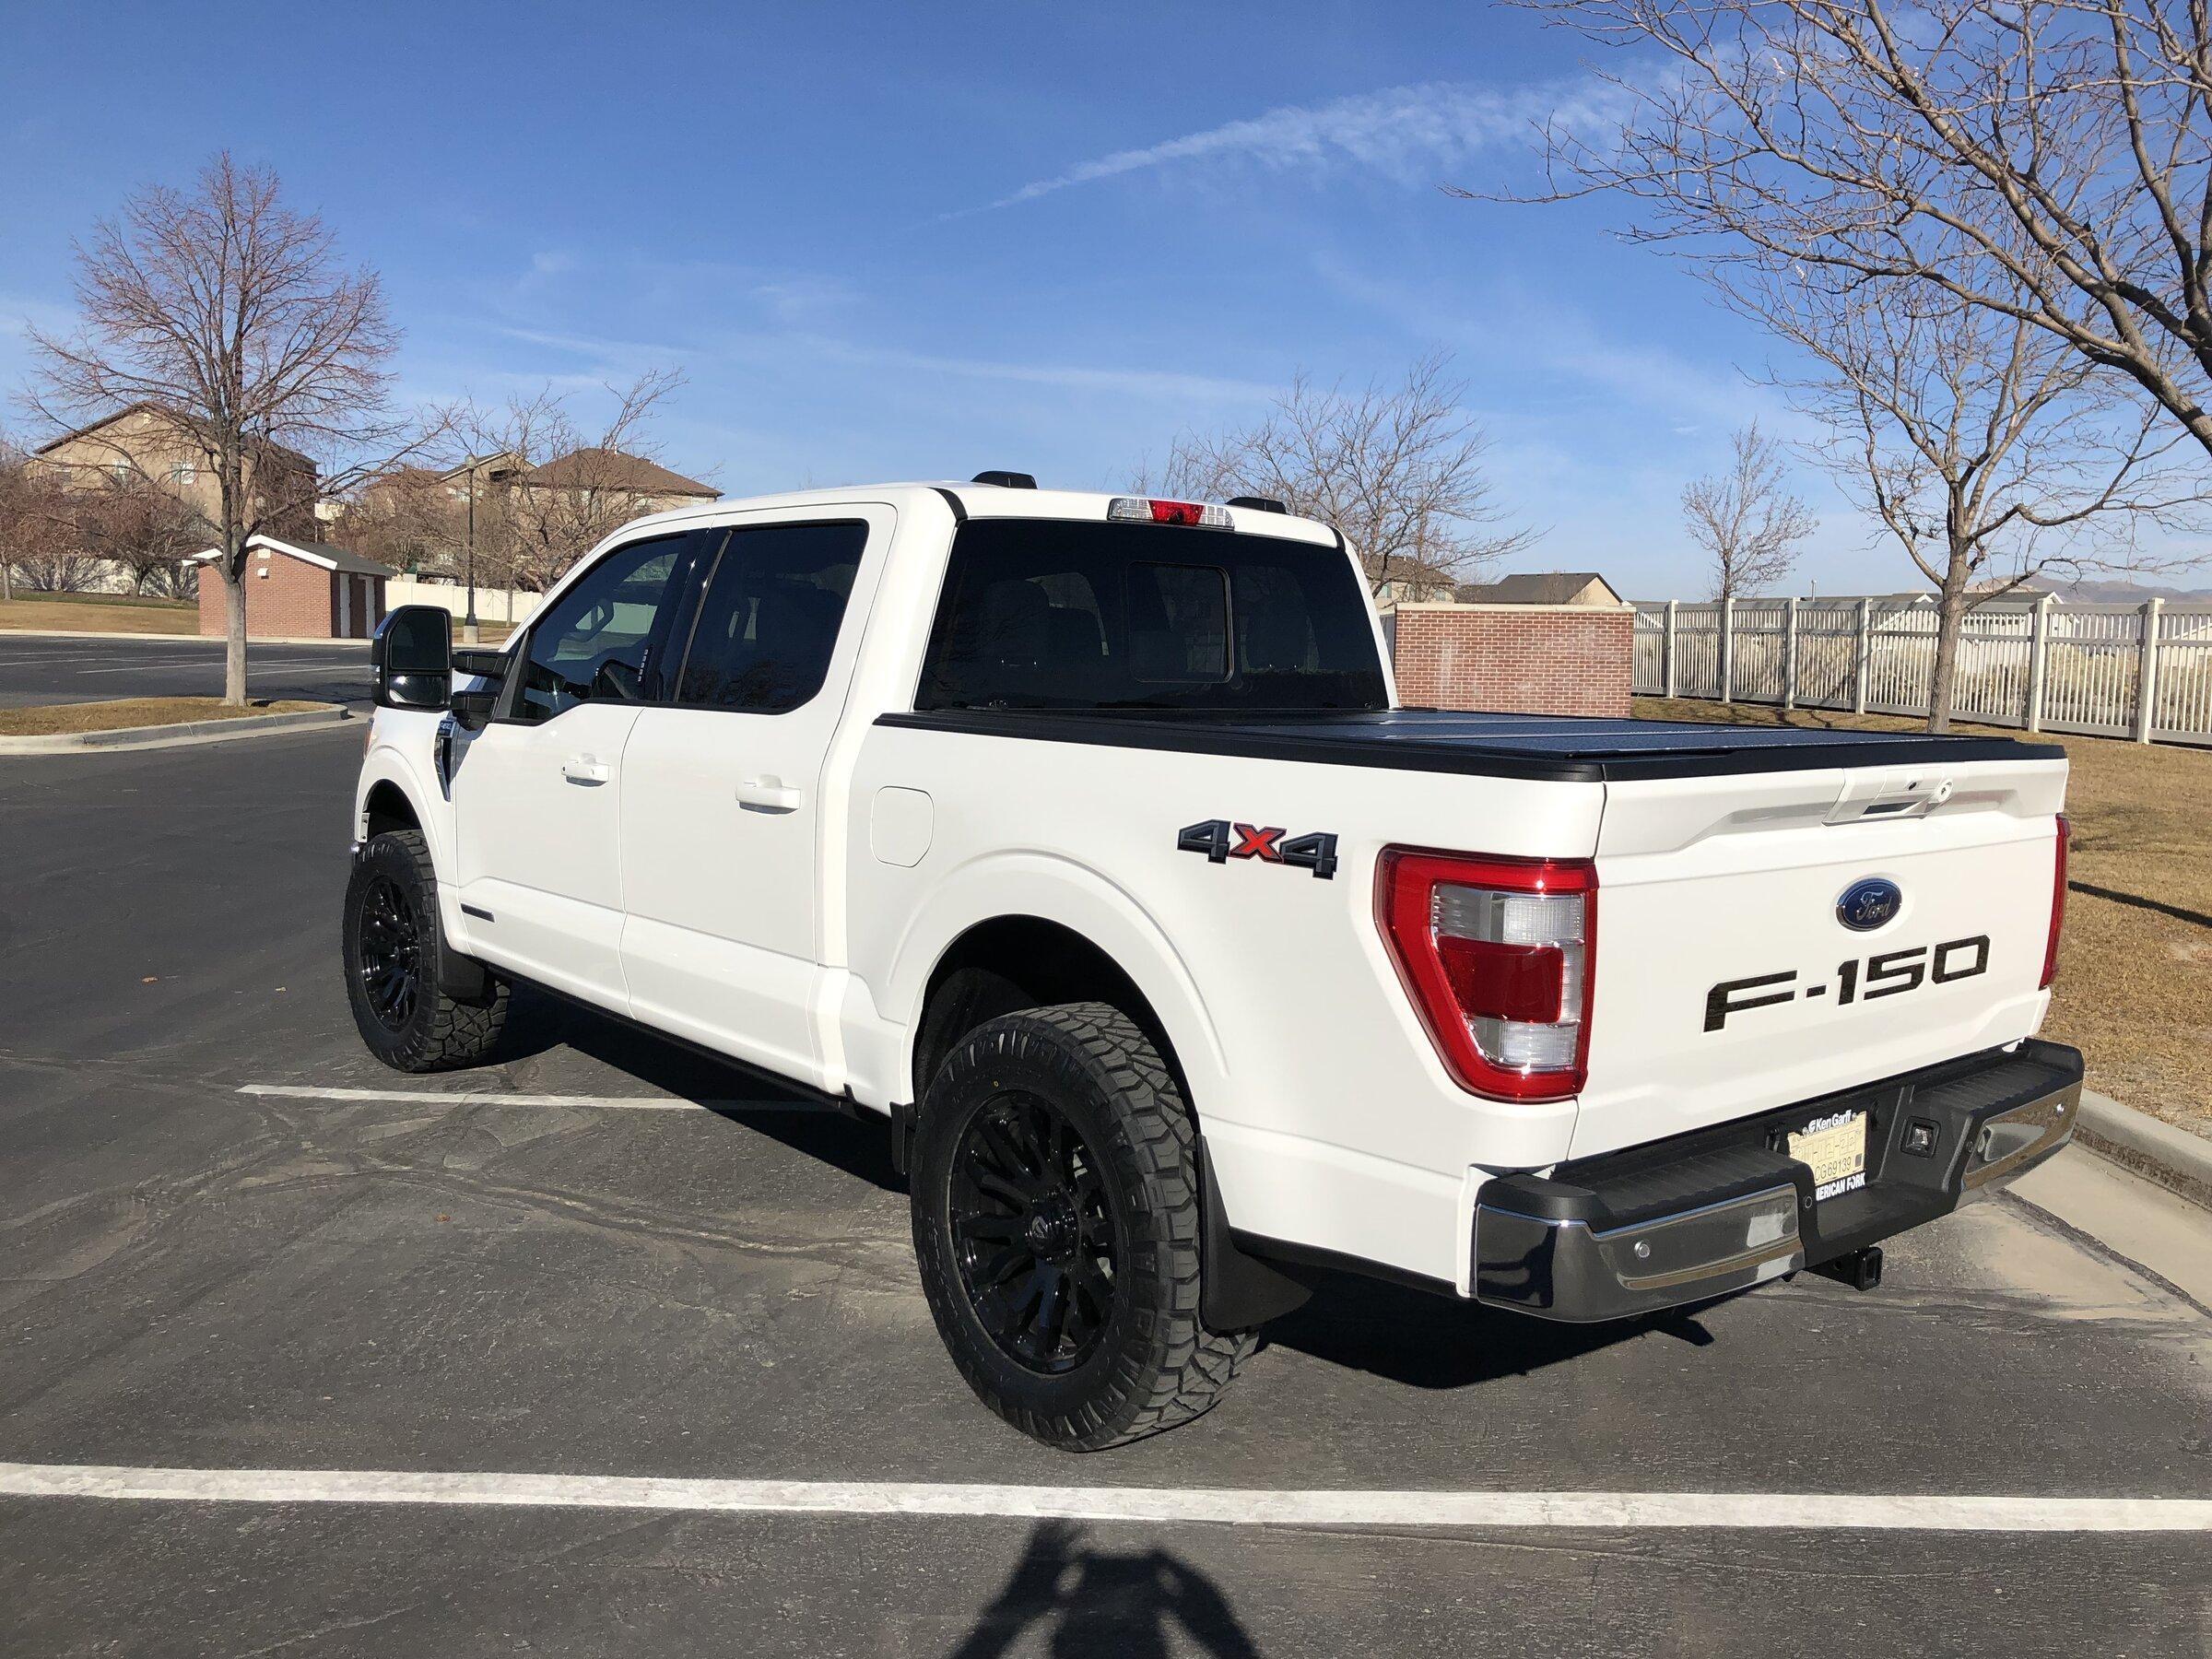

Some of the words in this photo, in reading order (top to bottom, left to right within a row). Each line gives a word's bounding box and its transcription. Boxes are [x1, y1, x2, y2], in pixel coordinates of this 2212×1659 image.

[1855, 889, 1894, 921] Ford
[1702, 933, 1991, 1033] F-150
[1816, 1117, 1831, 1132] Ken
[1832, 1109, 1852, 1127] Garff
[1815, 1179, 1846, 1202] MERICAN
